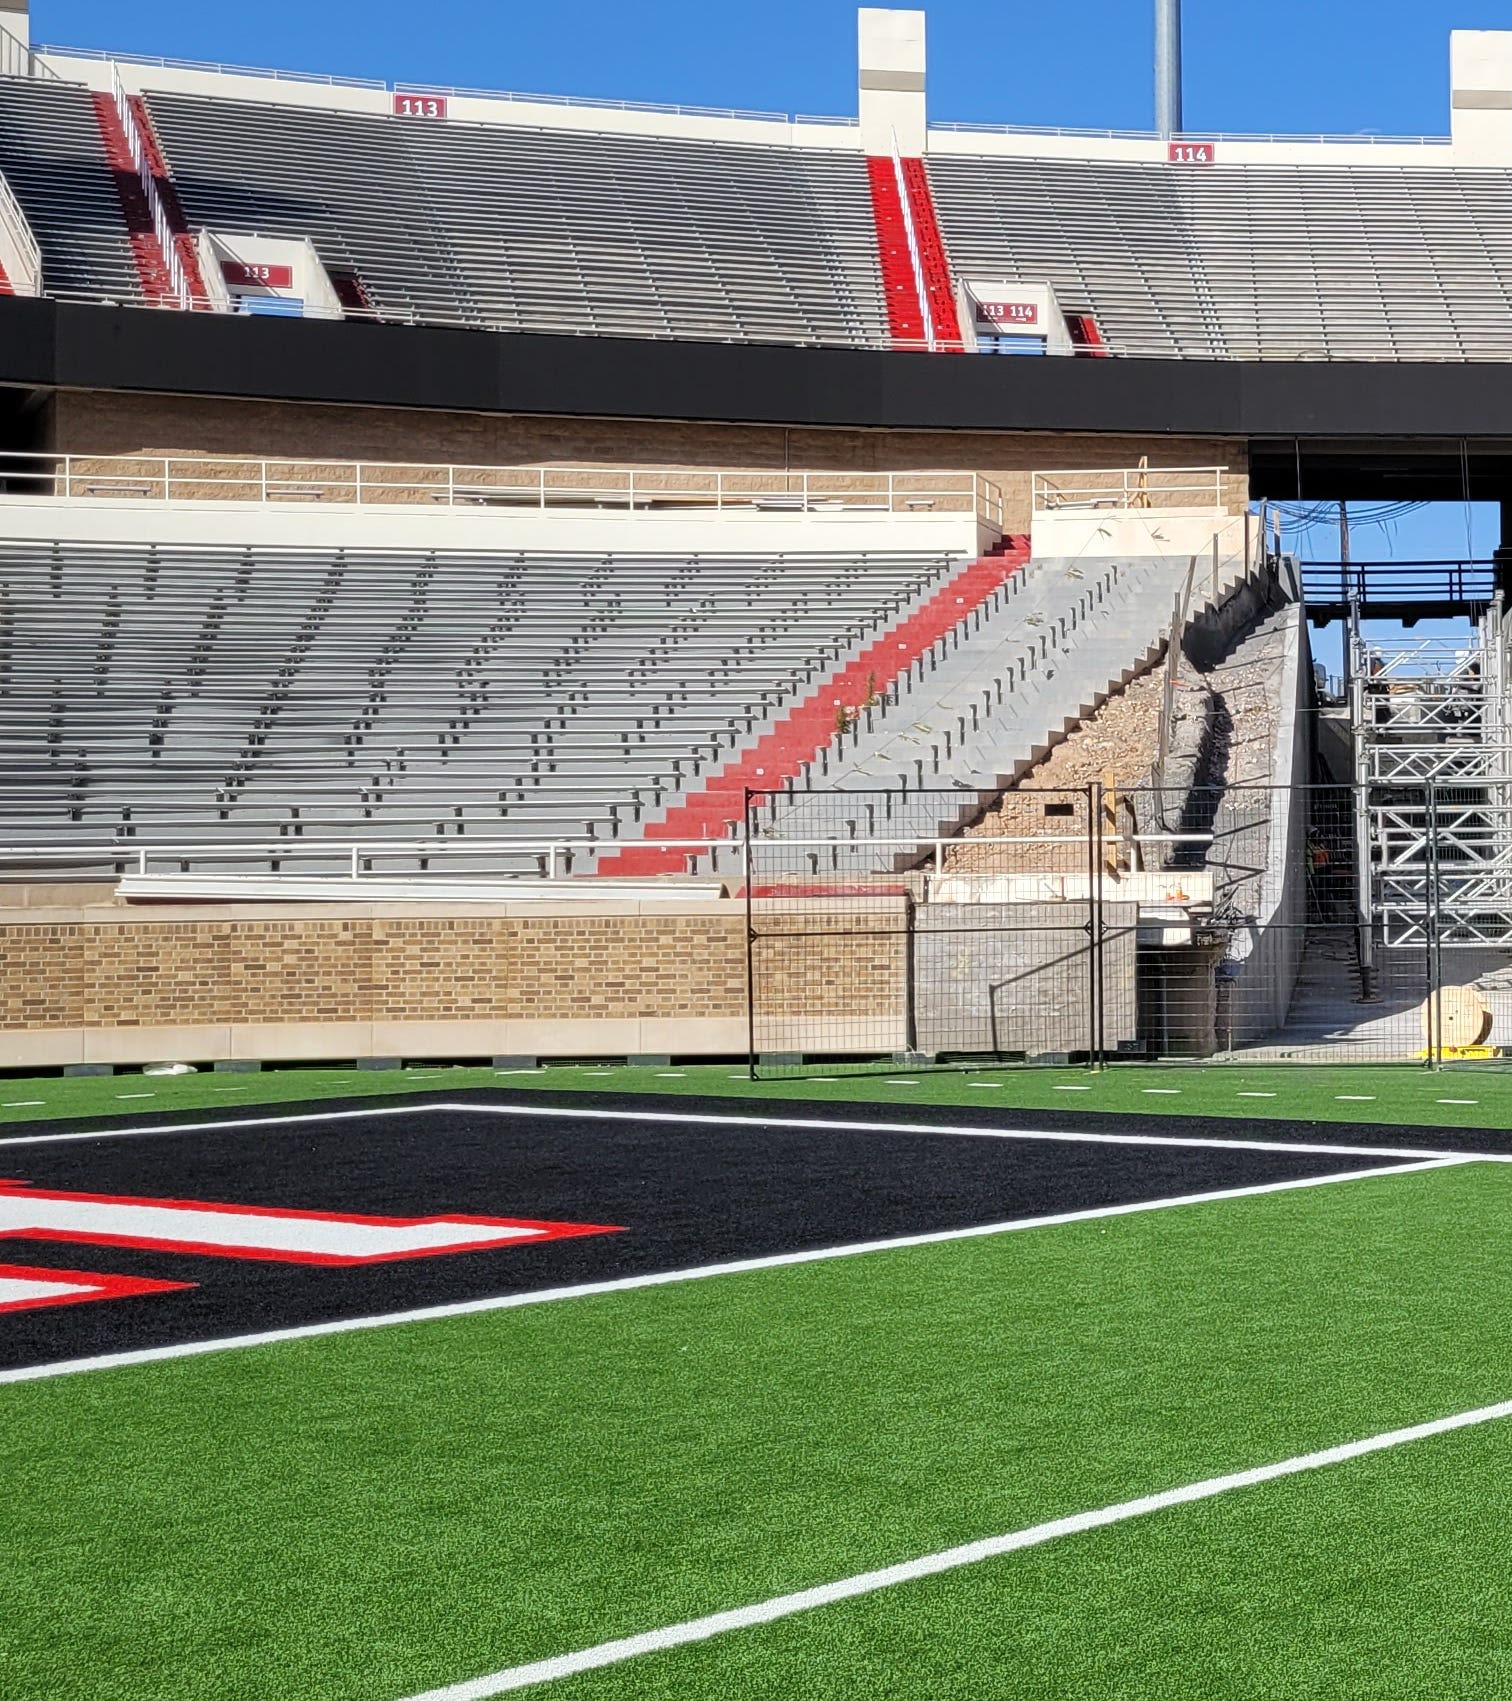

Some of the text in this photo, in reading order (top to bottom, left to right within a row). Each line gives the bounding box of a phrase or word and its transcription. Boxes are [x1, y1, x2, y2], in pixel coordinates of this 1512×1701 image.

[402, 99, 438, 117] 113
[1175, 147, 1207, 162] 114
[244, 266, 270, 279] 113
[983, 304, 1033, 317] 113 114
